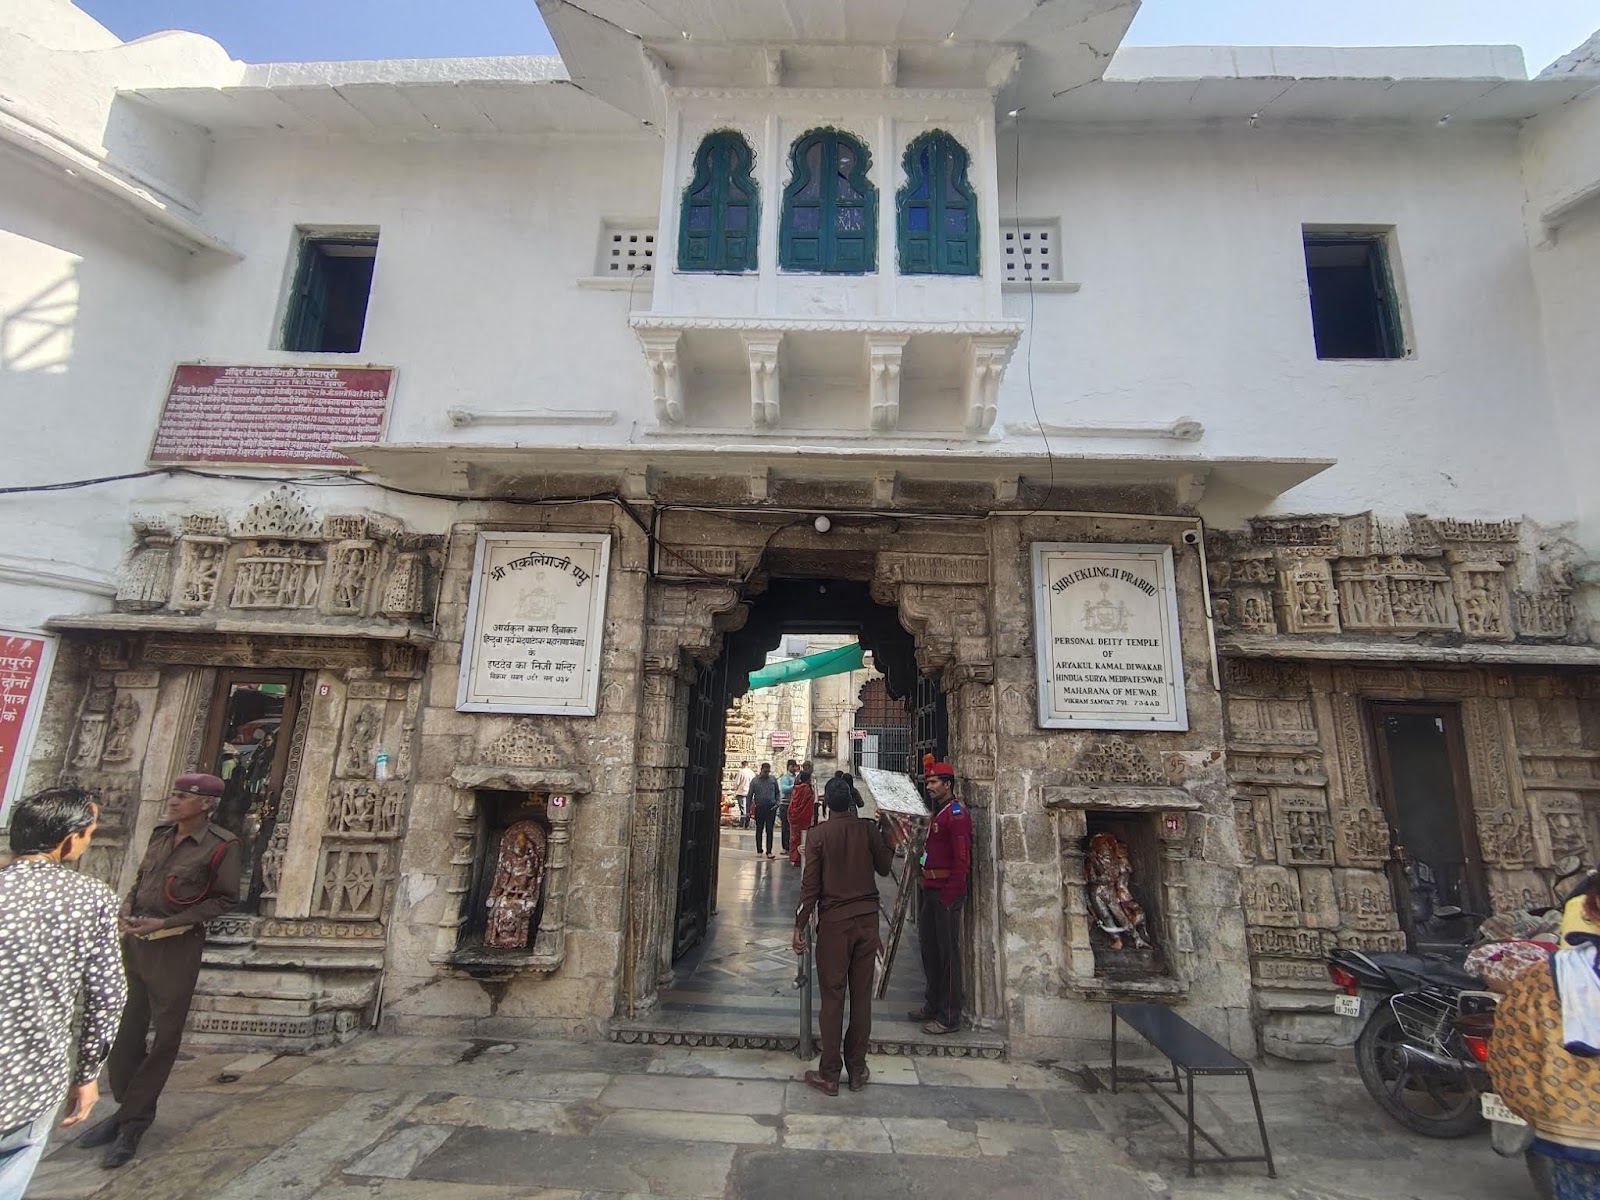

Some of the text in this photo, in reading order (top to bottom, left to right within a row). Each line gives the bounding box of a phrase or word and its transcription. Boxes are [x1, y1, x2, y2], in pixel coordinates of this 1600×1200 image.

[491, 565, 506, 581] श्री
[507, 551, 571, 571] एकलिंगजी
[1051, 566, 1158, 597] SHRI EKLINGJI PRABHU
[551, 623, 578, 636] दिवाकर
[1054, 637, 1160, 647] PERSONAL DEITY TEMPLE
[1102, 650, 1114, 658] OF
[515, 661, 528, 669] का
[531, 659, 552, 671] निजी
[1055, 661, 1163, 671] ARYAKUL KAMAL DIWAKAR
[1055, 674, 1164, 684] HINDUA SURYA MEDPATESWAR
[1063, 686, 1110, 695] MAHARANA
[1063, 697, 1089, 705] VIKRAM
[1343, 1006, 1358, 1016] 3107
